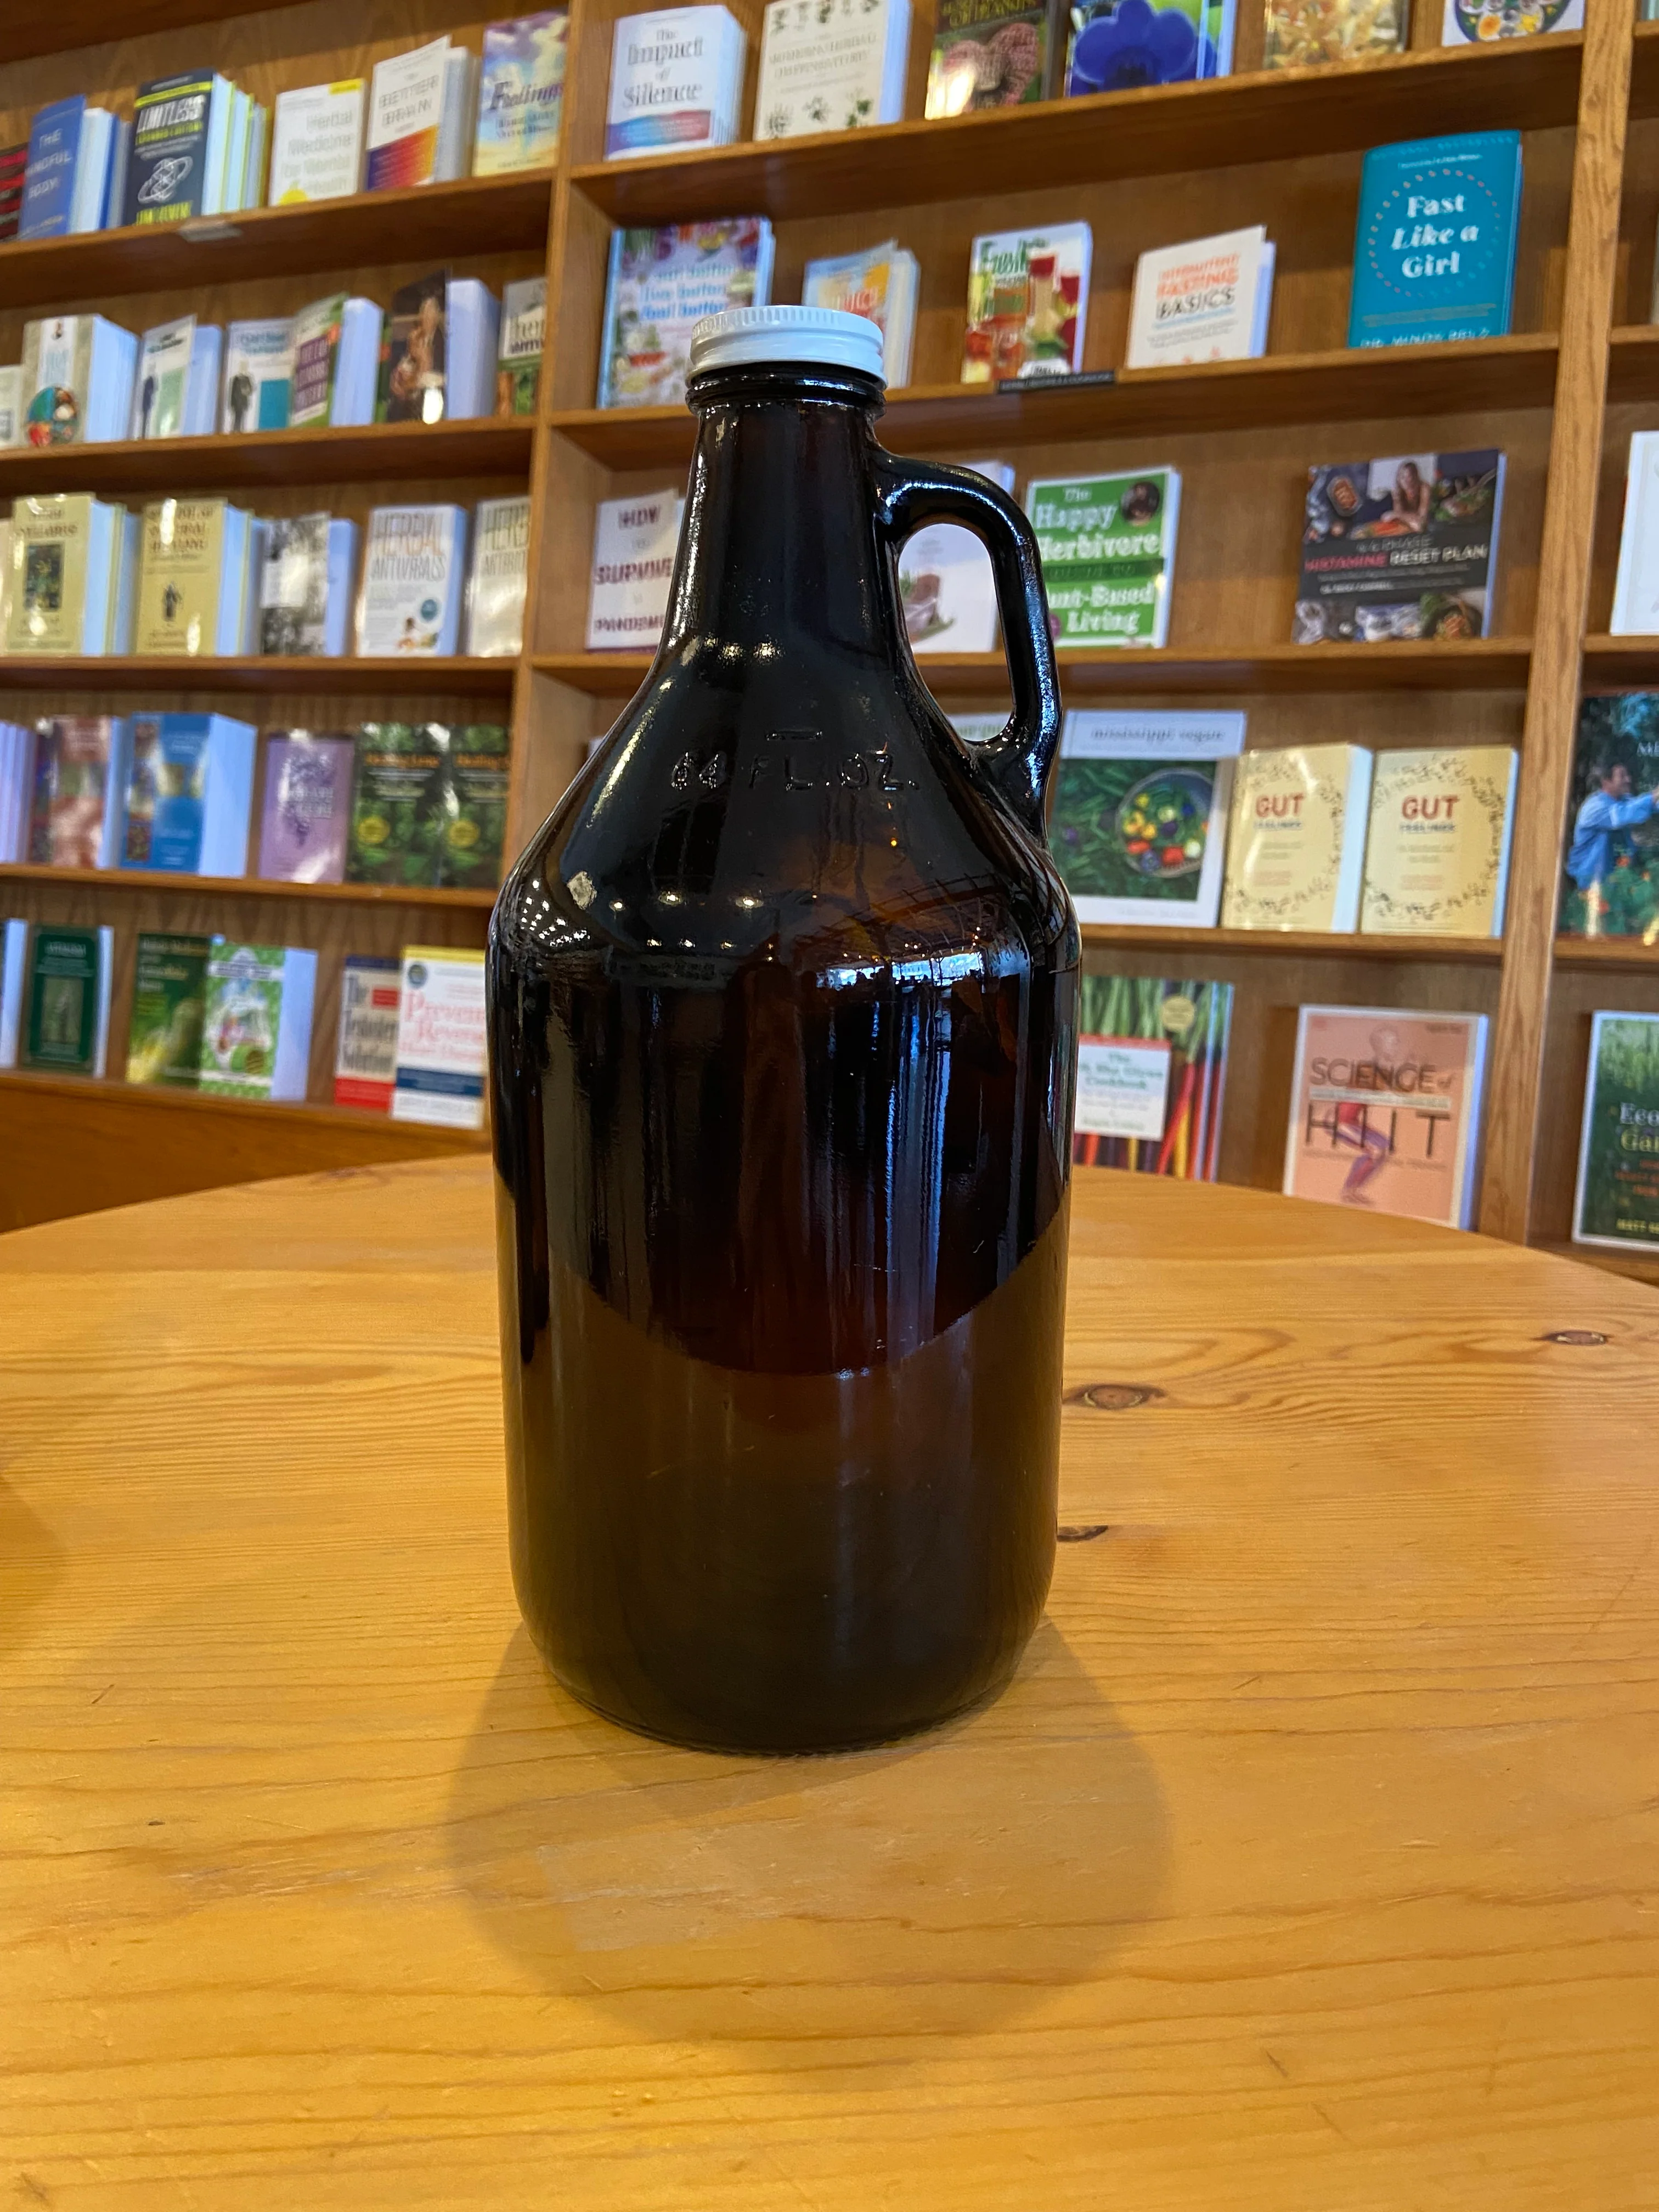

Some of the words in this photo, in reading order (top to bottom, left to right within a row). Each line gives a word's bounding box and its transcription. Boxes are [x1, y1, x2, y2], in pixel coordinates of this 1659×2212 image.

[627, 36, 703, 66] Impact
[623, 83, 703, 108] Silence
[1407, 194, 1465, 218] Fast
[1391, 223, 1454, 250] Like
[1460, 224, 1480, 242] a
[1402, 251, 1461, 278] Girl
[1063, 487, 1092, 502] The
[1036, 503, 1118, 531] Happy
[371, 554, 447, 582] ANTIVIRALS
[1389, 549, 1441, 566] RESET
[1442, 544, 1487, 561] PLAN
[1067, 609, 1140, 634] Living
[1255, 792, 1306, 817] GUT
[1402, 794, 1460, 820] GUT
[1310, 1056, 1437, 1093] SCIENCE
[1306, 1101, 1451, 1158] HIIT
